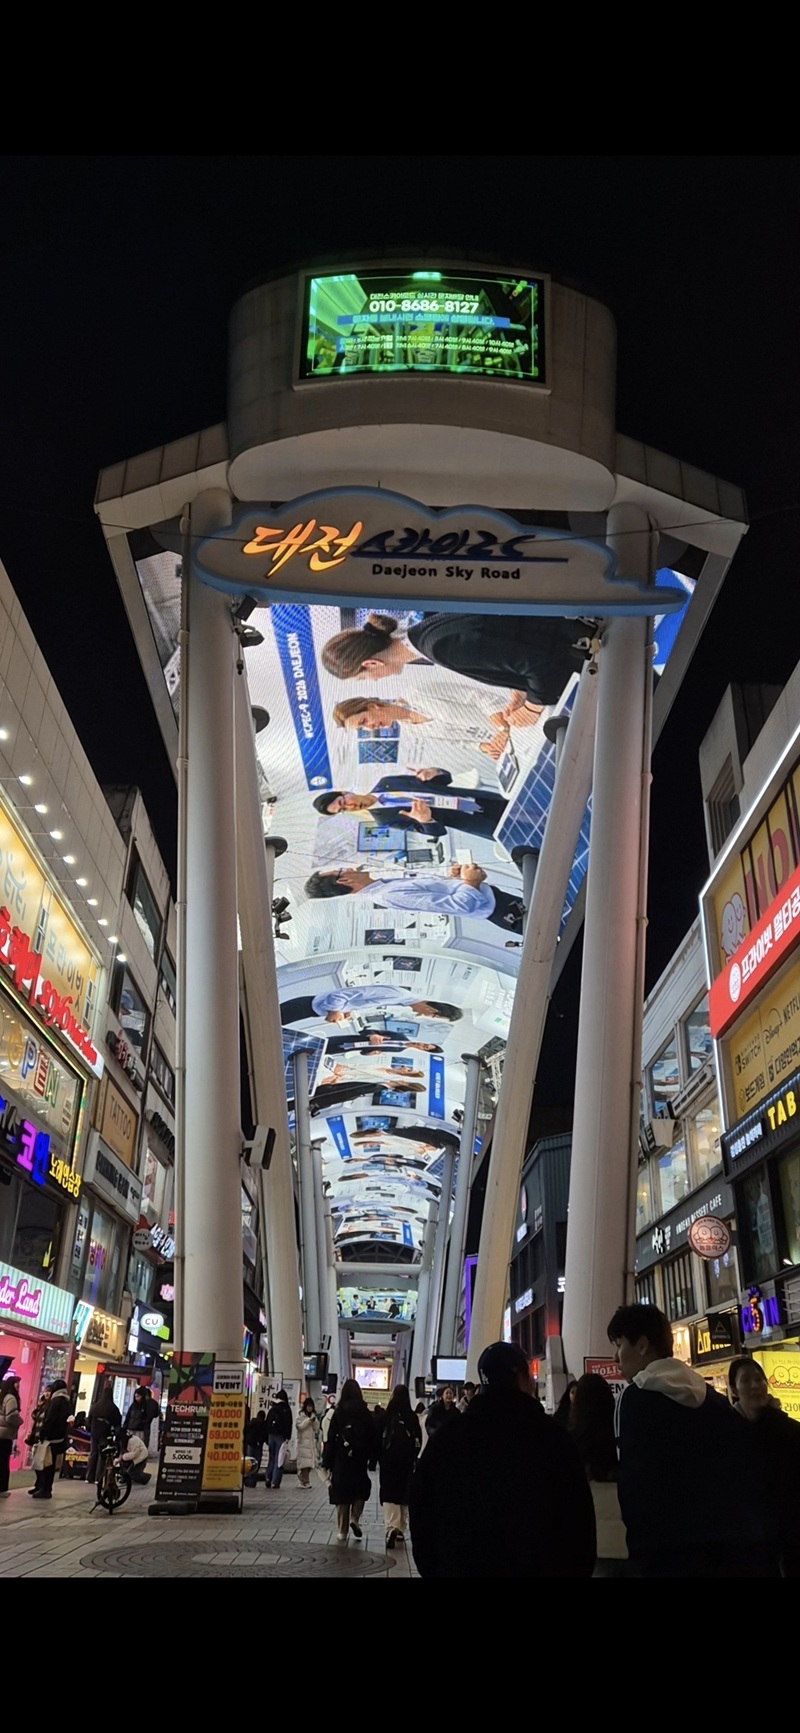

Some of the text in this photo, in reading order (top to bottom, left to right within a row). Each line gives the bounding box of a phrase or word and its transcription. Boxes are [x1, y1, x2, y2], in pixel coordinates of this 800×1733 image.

[369, 299, 480, 314] 010-8686-8127
[243, 518, 363, 579] 대전
[372, 564, 521, 580] Daejeon Sky Road
[286, 631, 305, 679] DAEJEON
[741, 922, 773, 984] 프라이빗
[741, 1044, 762, 1070] SWITCH
[744, 1071, 765, 1102] 보드게임
[110, 1094, 132, 1141] TATTOO
[767, 1090, 797, 1131] TAB
[16, 1119, 51, 1187] 코인
[49, 1153, 81, 1198] 노래연습장
[709, 1193, 722, 1211] CAFE
[15, 1282, 42, 1315] Land
[144, 1318, 159, 1326] CU
[215, 1381, 242, 1390] EVENT
[170, 1404, 207, 1414] TECHRUN
